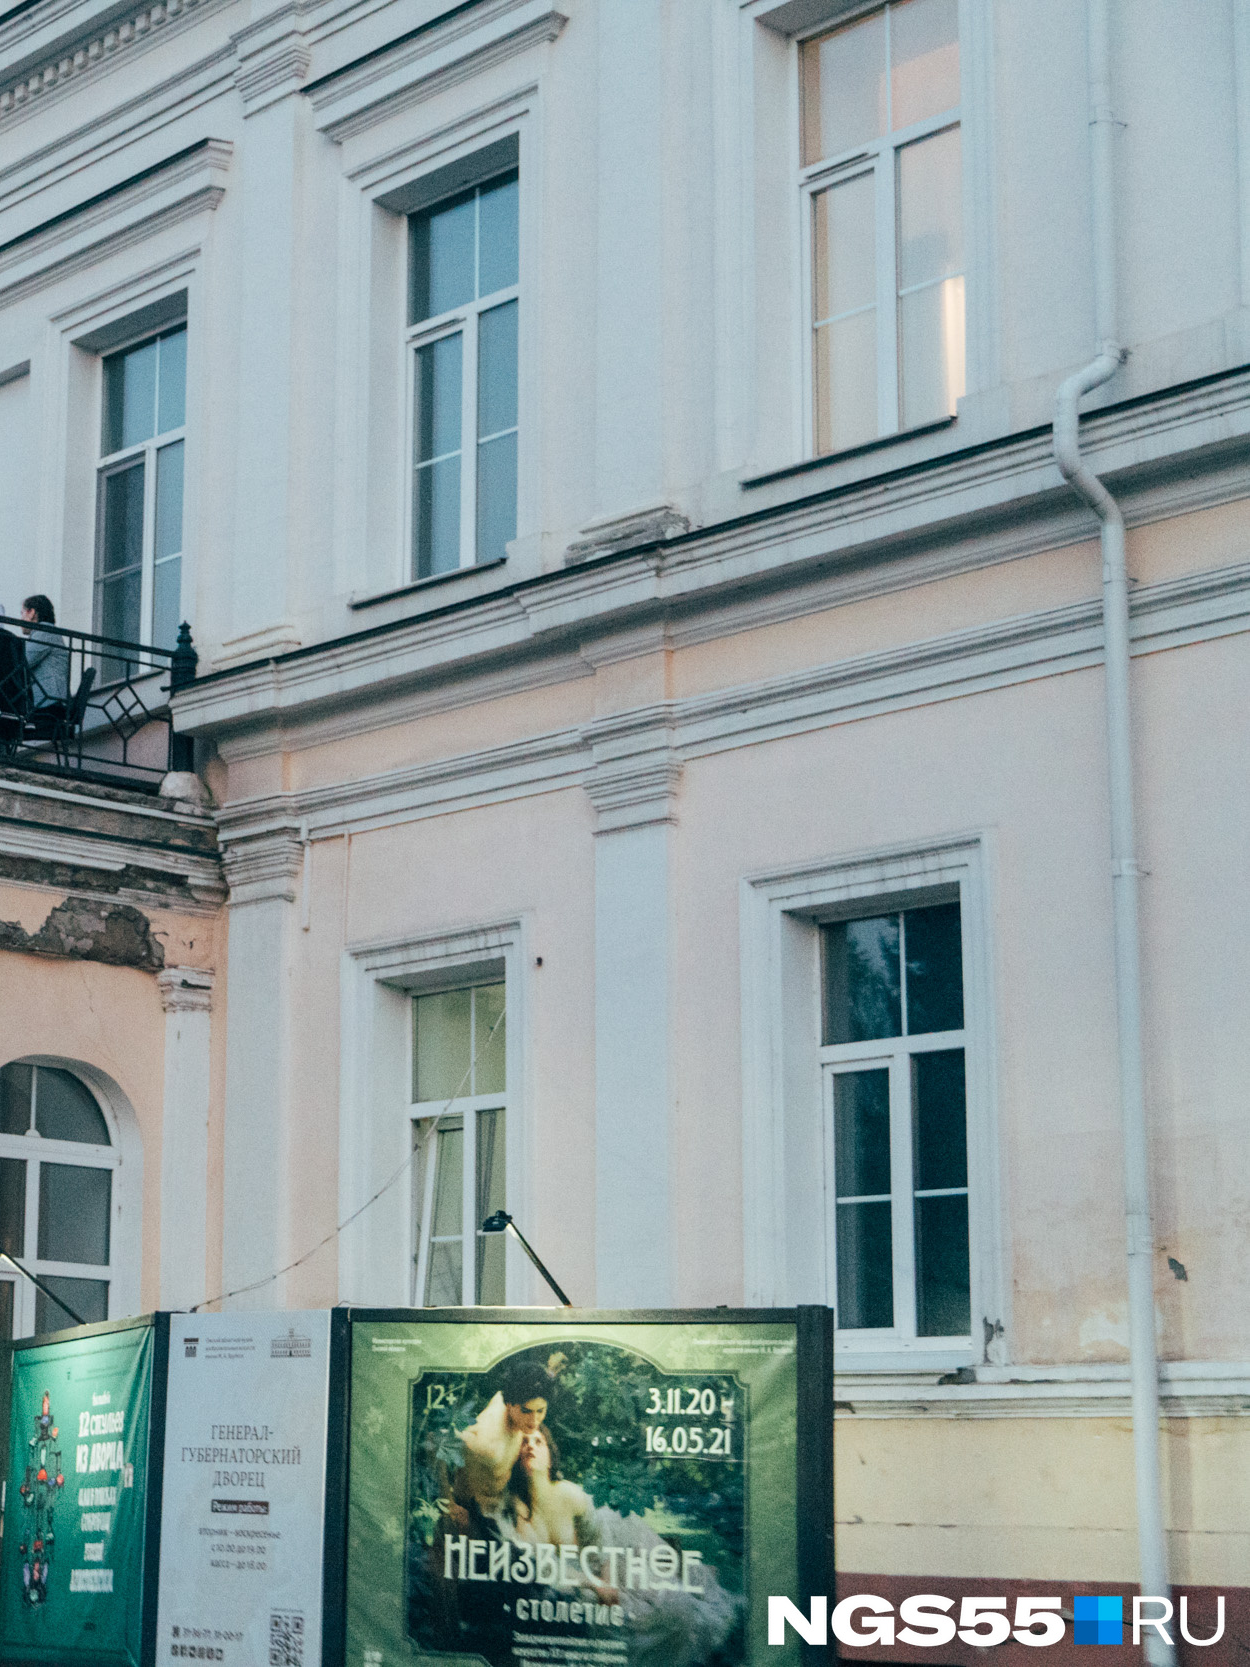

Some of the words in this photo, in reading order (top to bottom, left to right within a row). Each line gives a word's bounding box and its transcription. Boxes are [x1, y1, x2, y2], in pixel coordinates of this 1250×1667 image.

[645, 1387, 716, 1415] 3.11.20
[211, 1424, 274, 1441] ГЕНЕРАЛ-
[645, 1425, 732, 1455] 16.05.21
[181, 1445, 301, 1465] ГУБЕРНАТОРСКИЙ
[212, 1470, 265, 1488] ДВОРЕЦ
